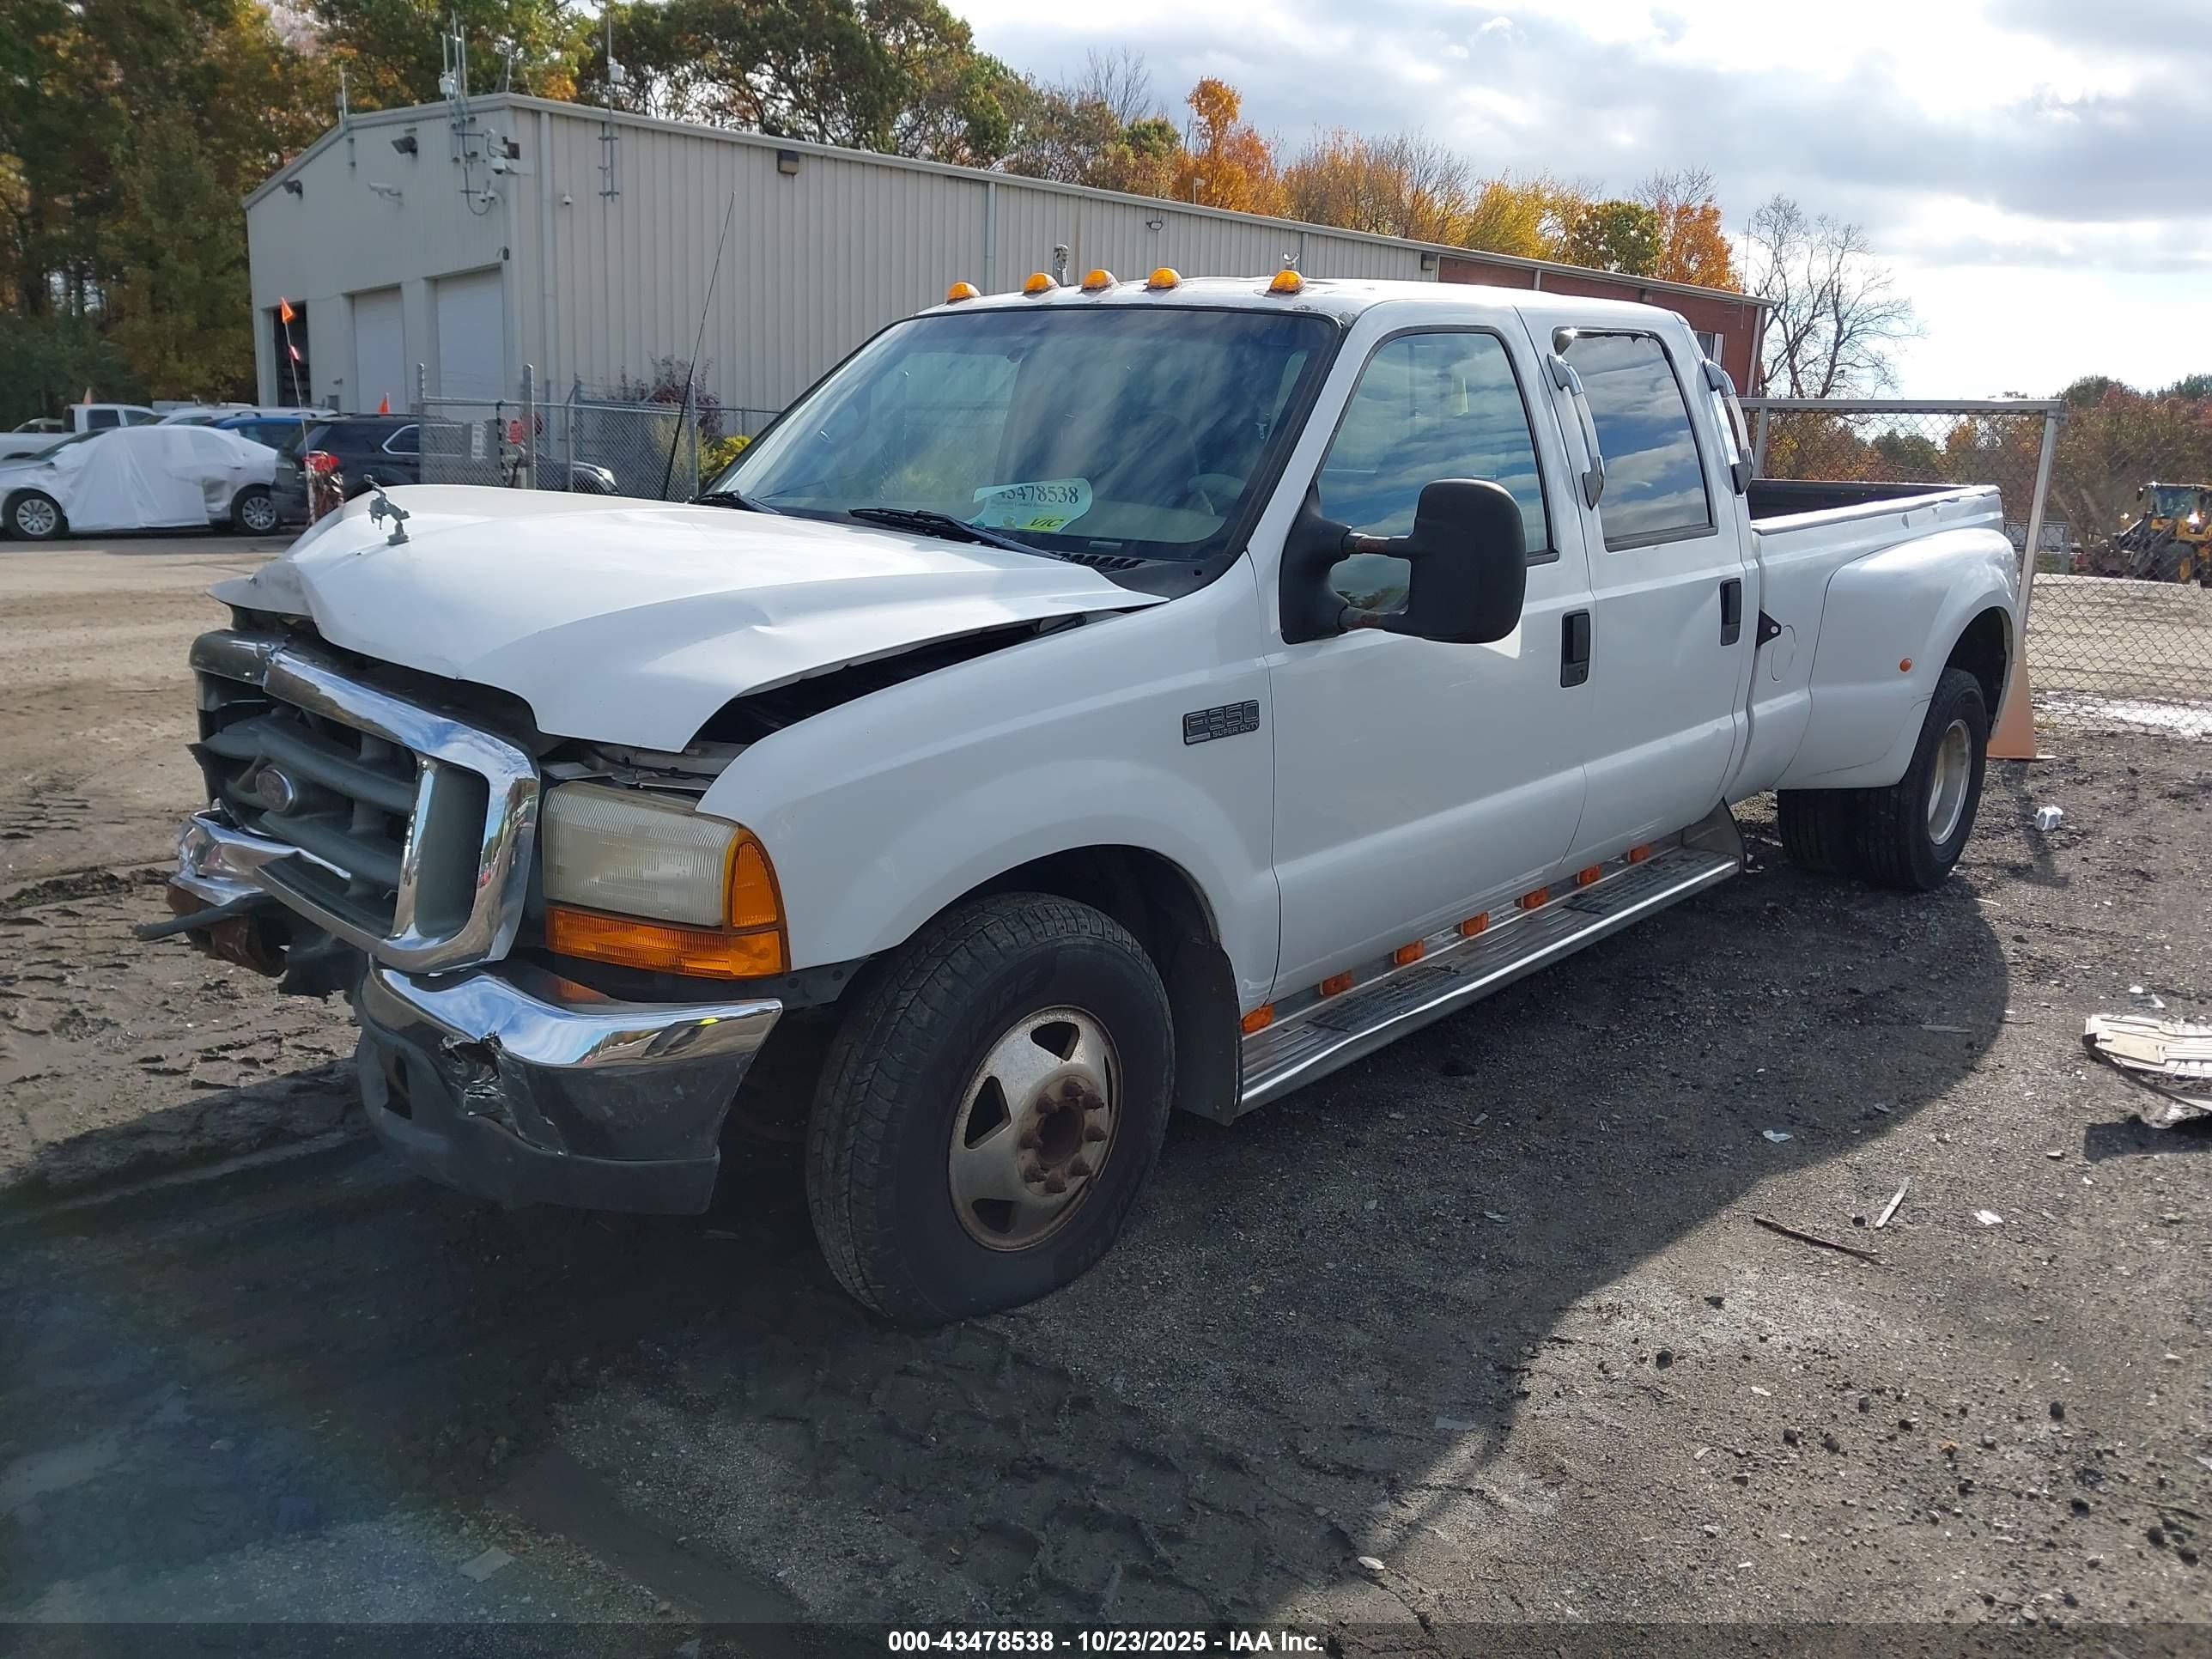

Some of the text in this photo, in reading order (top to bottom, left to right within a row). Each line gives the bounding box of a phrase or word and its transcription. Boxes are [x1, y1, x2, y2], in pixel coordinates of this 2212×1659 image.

[1030, 518, 1065, 527] VIC
[1212, 726, 1237, 738] SUPER
[1239, 721, 1259, 732] DUTY
